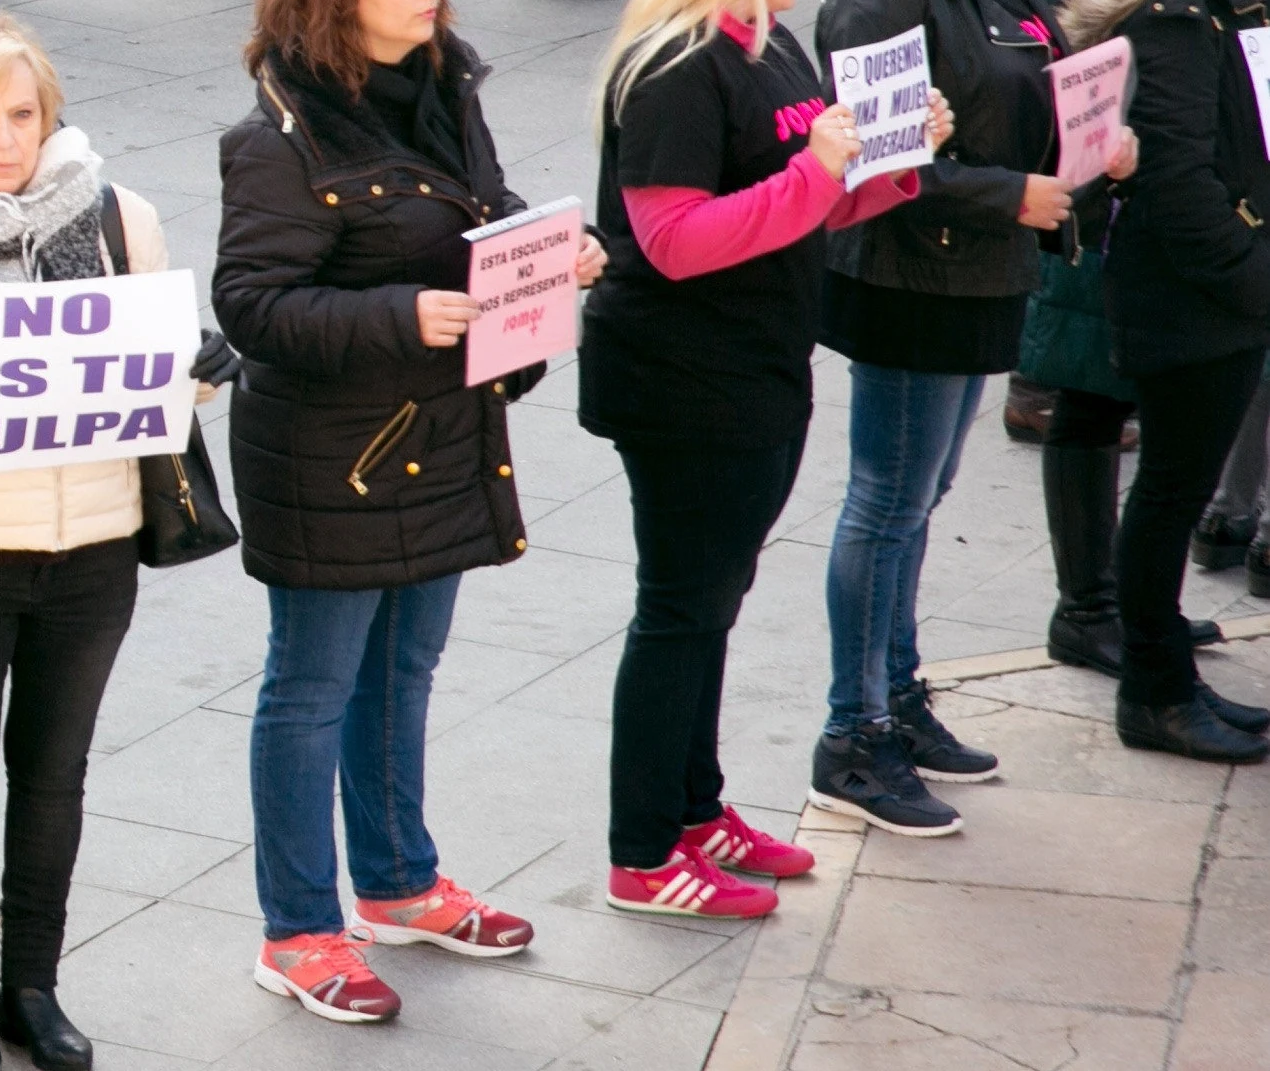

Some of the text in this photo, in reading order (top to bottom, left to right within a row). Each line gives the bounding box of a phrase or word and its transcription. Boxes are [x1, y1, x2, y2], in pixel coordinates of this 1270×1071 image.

[864, 37, 923, 86] QUEREMOS
[889, 80, 927, 118] MUJER
[480, 229, 569, 271] ESTA ESCULTURA
[517, 263, 534, 279] NO
[478, 271, 569, 314] NOS REPRESENTA
[3, 292, 111, 338] NO
[72, 352, 175, 394] TU
